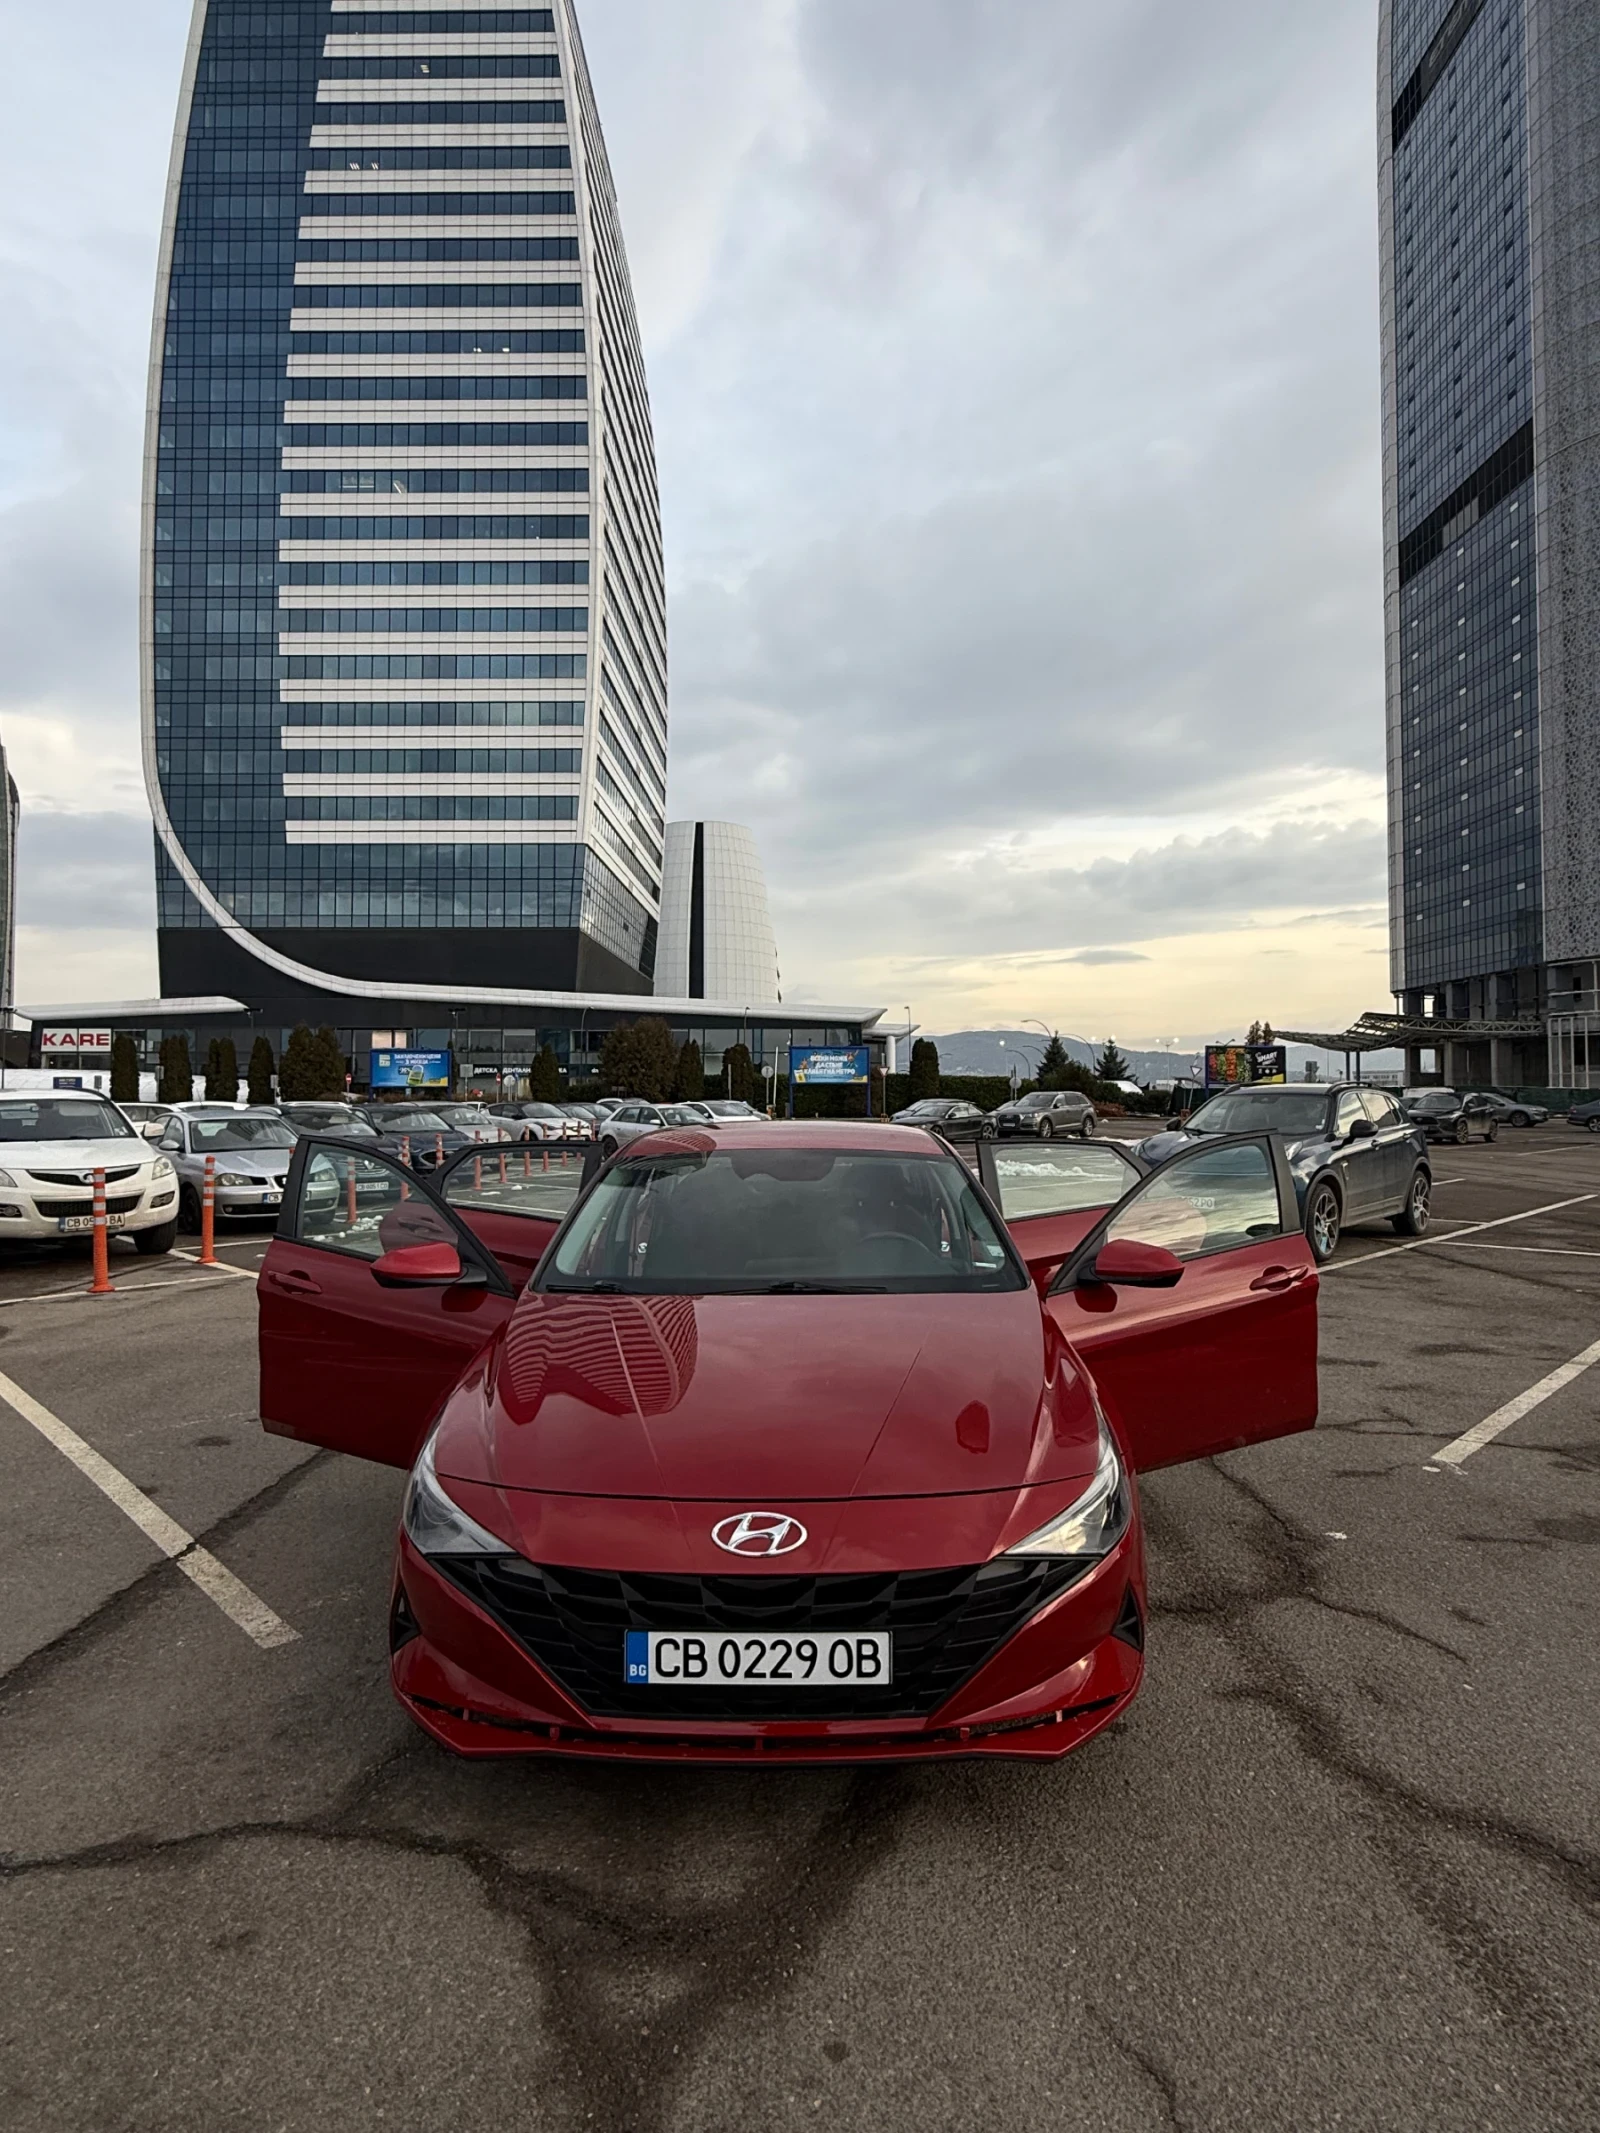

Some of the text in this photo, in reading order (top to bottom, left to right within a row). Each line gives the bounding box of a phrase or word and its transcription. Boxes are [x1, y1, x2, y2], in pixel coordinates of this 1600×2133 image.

[43, 1033, 110, 1046] KARE
[473, 1067, 498, 1075] ДЕТСКА
[66, 1218, 80, 1228] CB
[109, 1214, 123, 1225] BA
[629, 1664, 647, 1676] BG
[655, 1638, 708, 1678] CB
[718, 1639, 818, 1679] 0229
